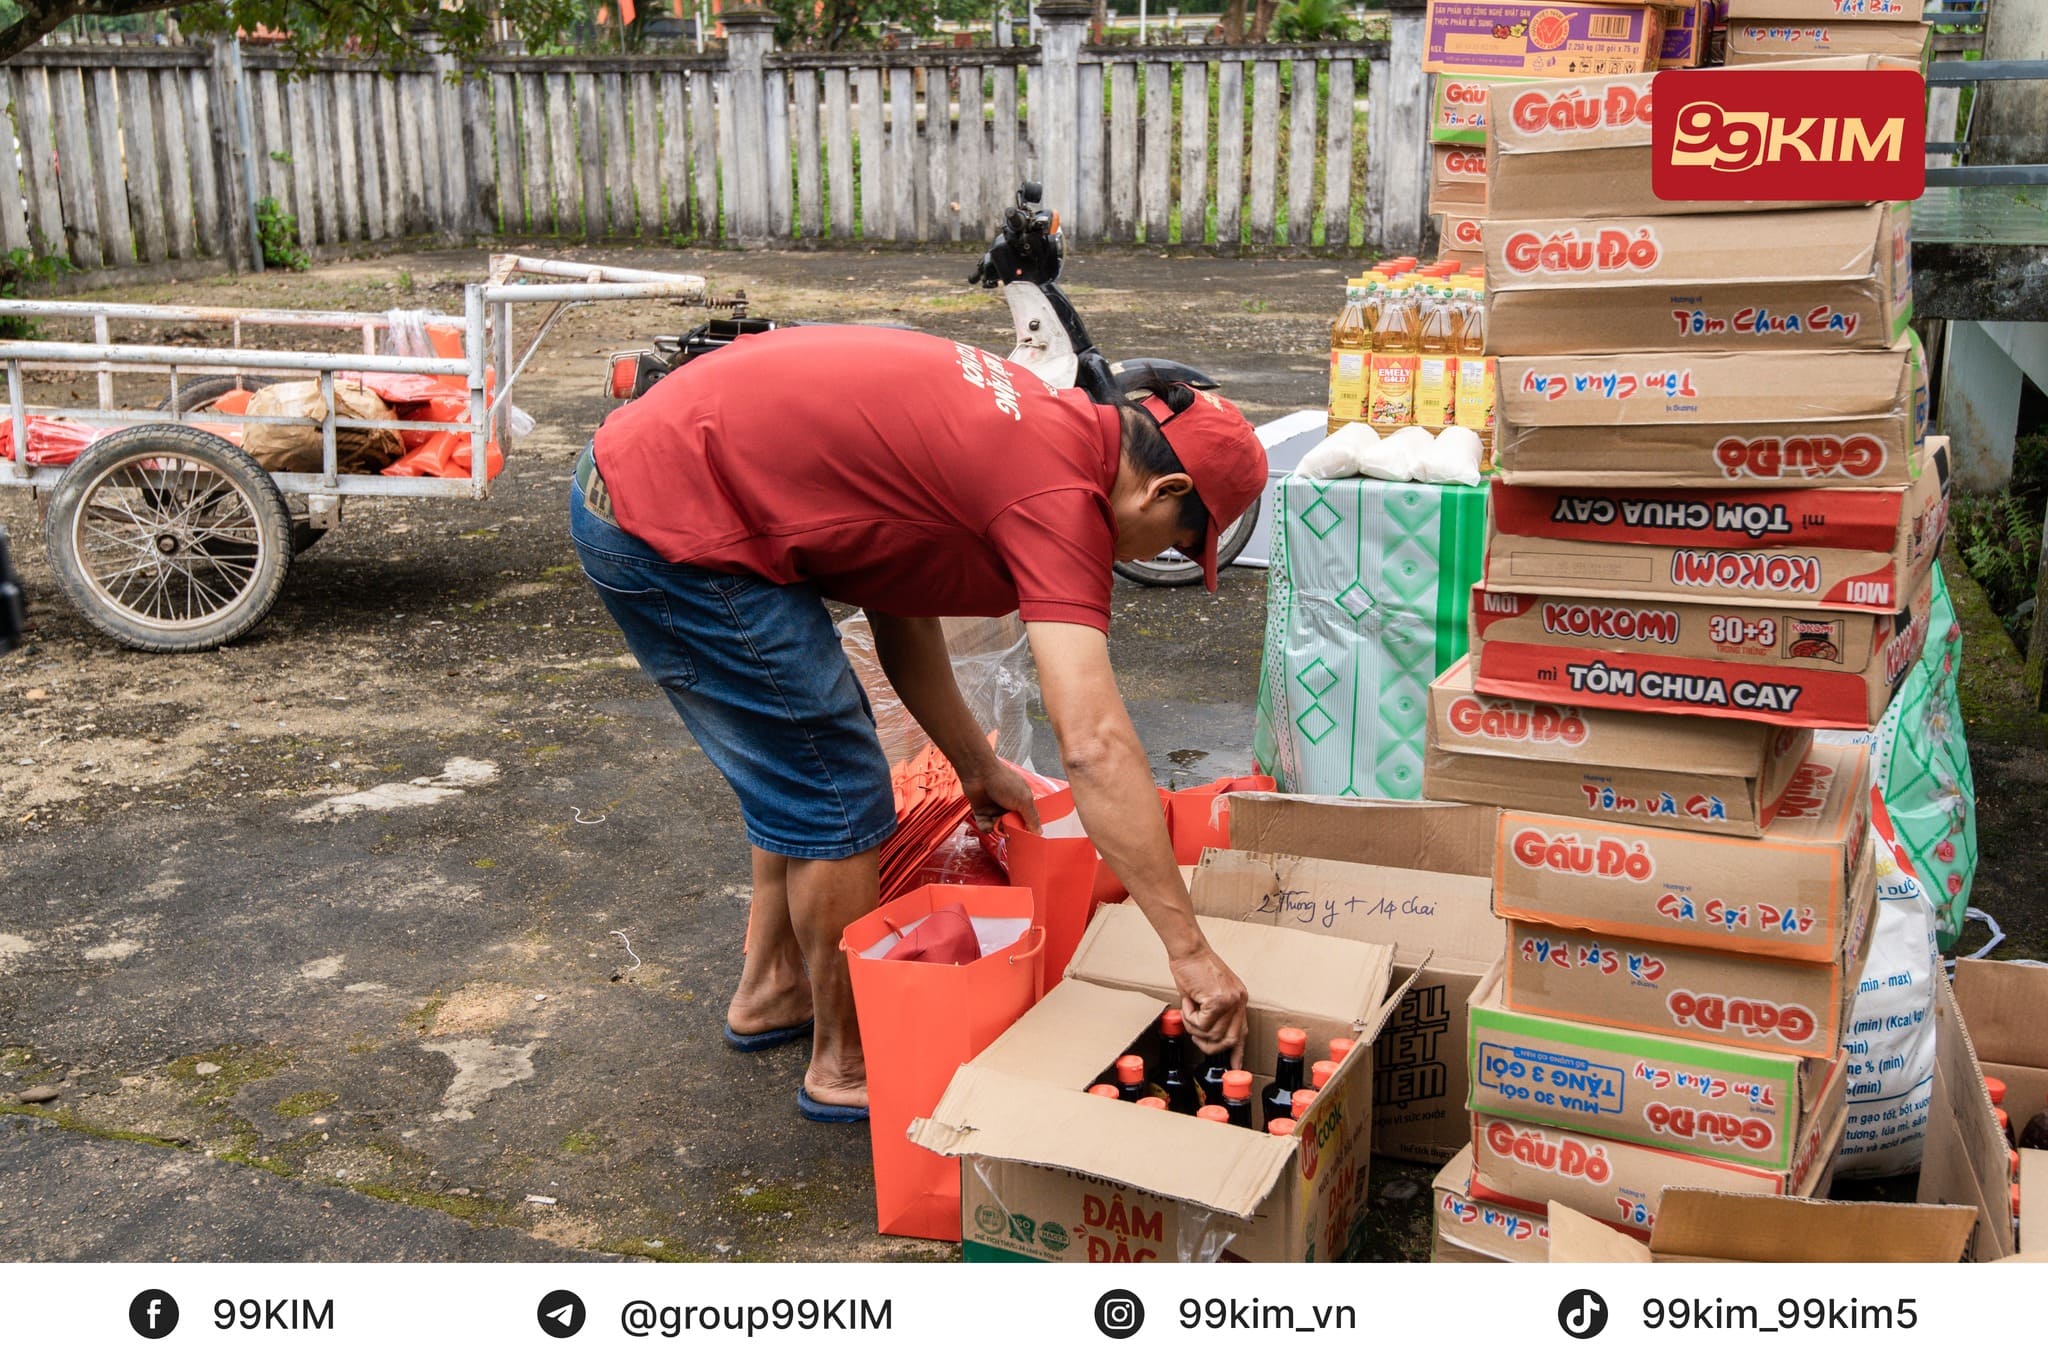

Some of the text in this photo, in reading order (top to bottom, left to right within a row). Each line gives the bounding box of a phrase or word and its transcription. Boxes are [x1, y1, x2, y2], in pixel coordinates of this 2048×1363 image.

[1742, 24, 1830, 43] Tôm Chua Cay
[1444, 113, 1465, 126] Tôm
[1513, 88, 1601, 133] Gấu
[1505, 228, 1659, 273] Gấu Đỏ
[1672, 305, 1860, 338] Tôm Chua Cay
[1378, 368, 1411, 377] EMELY
[1522, 370, 1697, 401] Tôm Chua Cay
[1716, 436, 1884, 480] Gấu Đỏ
[1553, 497, 1825, 539] mì TÔM CHUA CAY
[1672, 550, 1821, 592] KOKOMI
[1542, 603, 1680, 644] KOKOMI
[1709, 615, 1776, 647] 30+3
[1791, 623, 1834, 634] KOKOMI
[1538, 663, 1801, 712] mì TÔM CHUA CAY
[1448, 699, 1589, 746] Gấu Đỏ
[1581, 784, 1726, 821] Tôm và Gà
[1512, 829, 1653, 881] Gấu Đỏ
[1656, 894, 1695, 921] Gà
[1705, 898, 1748, 931] Sợi
[1758, 901, 1816, 936] Phở
[1520, 938, 1666, 983] Gà Sợi Phở
[1888, 970, 1912, 987] max)
[1669, 992, 1815, 1041] Gấu Đỏ
[1854, 1018, 1882, 1035] (min)
[1486, 1055, 1616, 1098] TẶNG 3 GÓI
[1633, 1062, 1775, 1106] Tôm Chua Cay
[1865, 1060, 1875, 1073] %
[1879, 1054, 1905, 1074] (min)
[1498, 1082, 1600, 1114] MUA 30 GÓI
[1860, 1113, 1880, 1126] gạo
[1899, 1102, 1912, 1116] bột
[1645, 1103, 1773, 1150] Gấu Đỏ
[1486, 1121, 1611, 1185] Gấu Đỏ
[1082, 1192, 1164, 1243] ĐẬM
[1442, 1194, 1479, 1224] Cay
[1484, 1208, 1533, 1241] Chua
